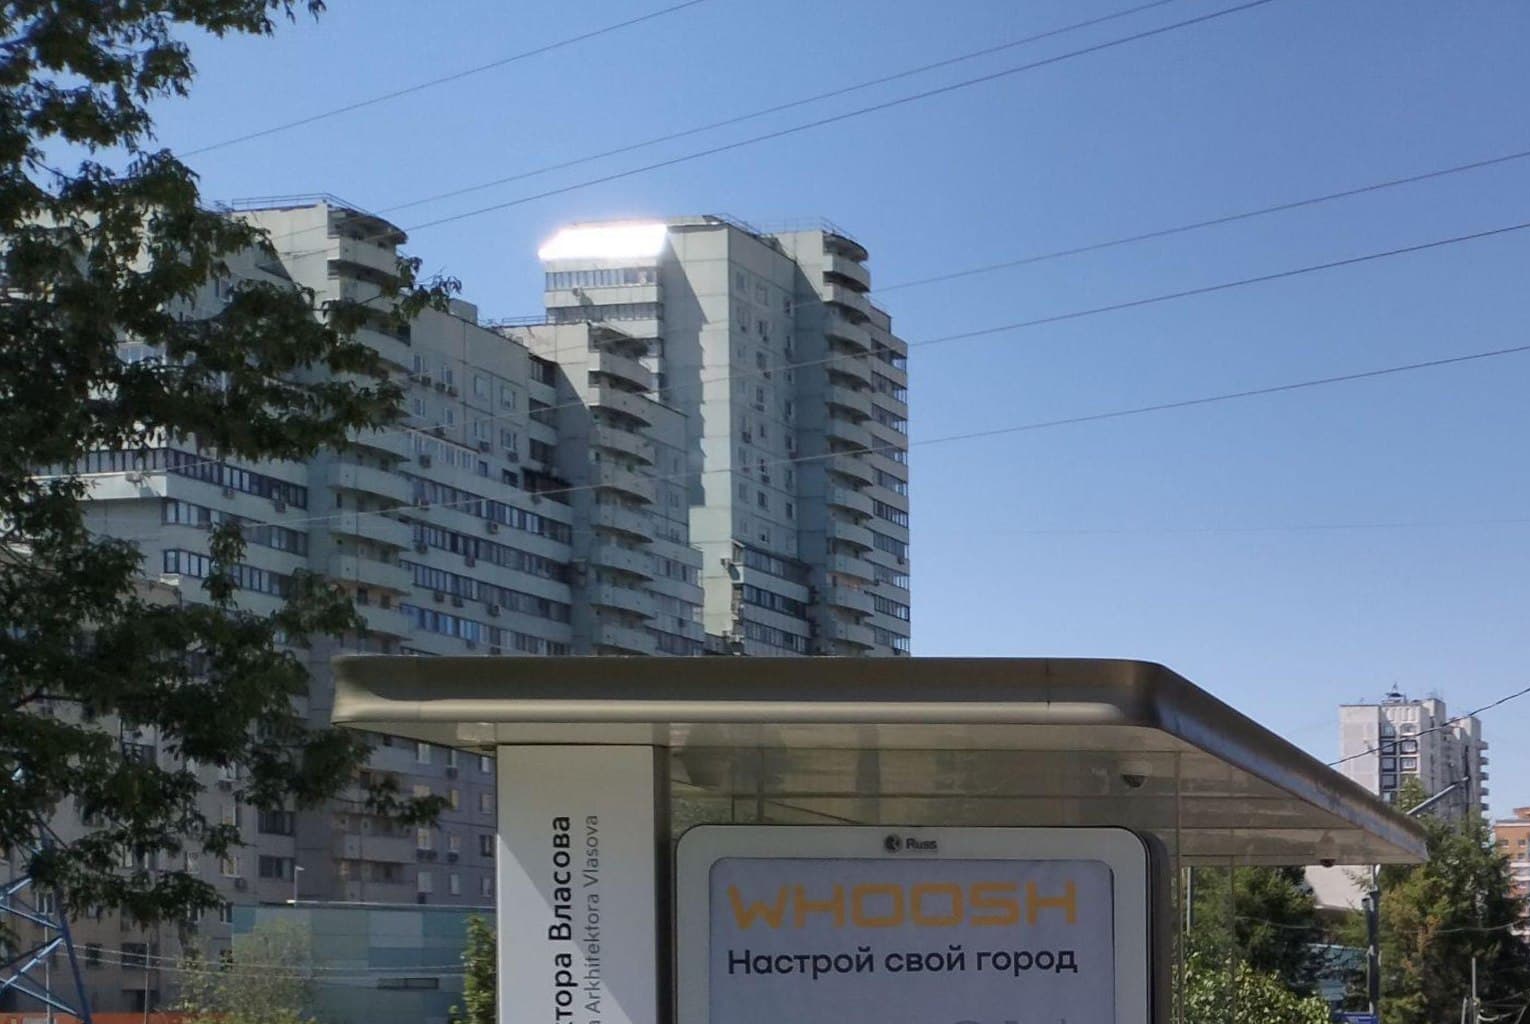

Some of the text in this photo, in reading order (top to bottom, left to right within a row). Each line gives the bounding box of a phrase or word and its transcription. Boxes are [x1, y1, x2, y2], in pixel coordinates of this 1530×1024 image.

[548, 816, 573, 941] Власова
[582, 815, 600, 888] Vlasova
[727, 880, 1077, 931] WHOOSH
[583, 893, 602, 1014] Arkhitektora
[728, 944, 1078, 980] Настрой свой город
